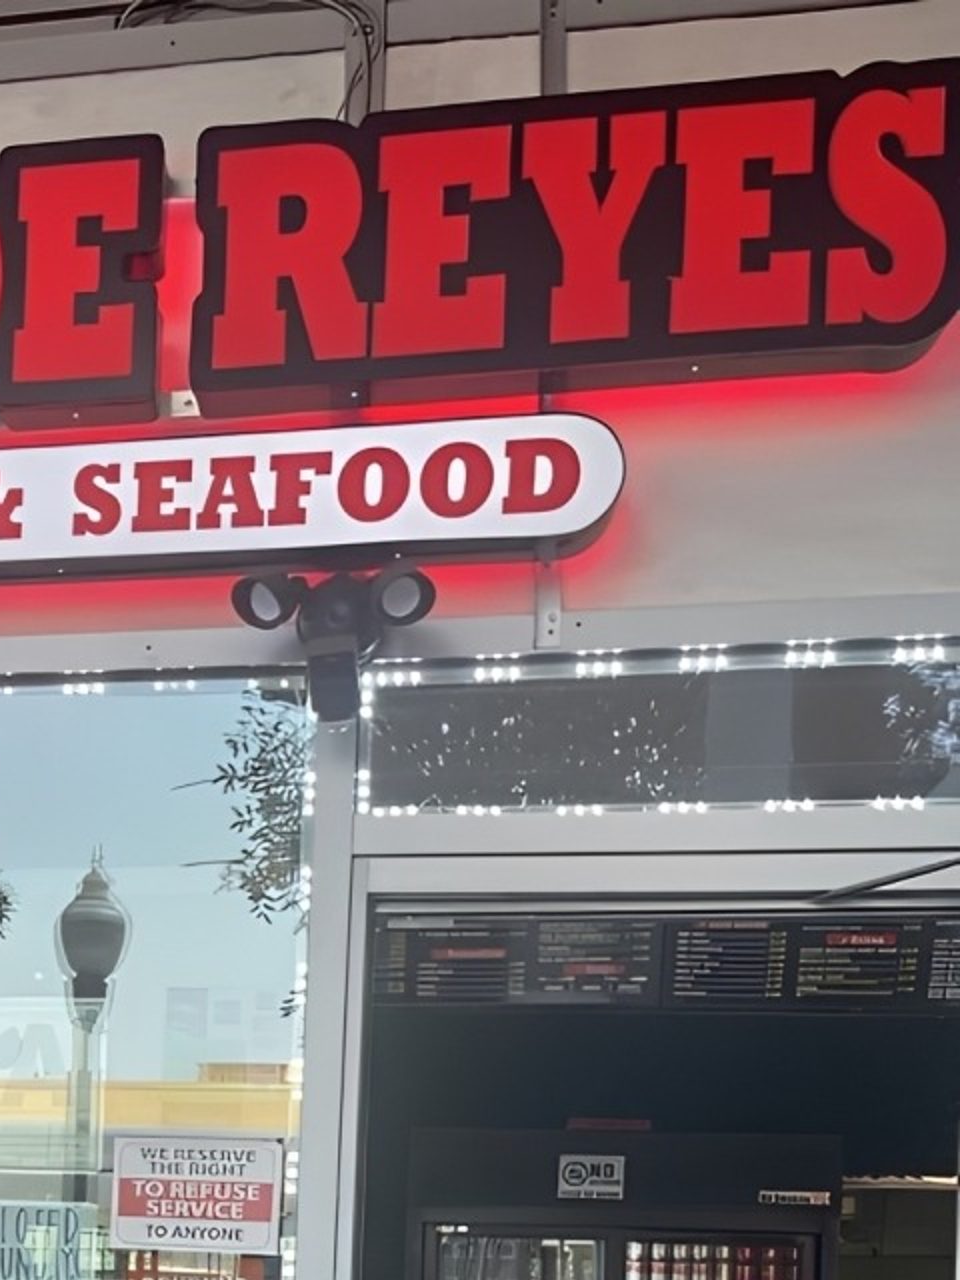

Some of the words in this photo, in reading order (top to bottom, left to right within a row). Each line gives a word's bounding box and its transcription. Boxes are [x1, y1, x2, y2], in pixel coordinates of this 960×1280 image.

[211, 86, 947, 369] REYES
[72, 437, 581, 537] SEAFOOD
[140, 1147, 169, 1160] WE
[173, 1148, 257, 1163] RESERVE
[151, 1161, 185, 1176] THE
[189, 1162, 247, 1177] RIGHT
[131, 1180, 165, 1198] TO
[169, 1181, 261, 1201] REFUSE
[146, 1199, 244, 1219] SERVICE
[146, 1224, 168, 1239] TO
[171, 1225, 244, 1242] ANYONE
